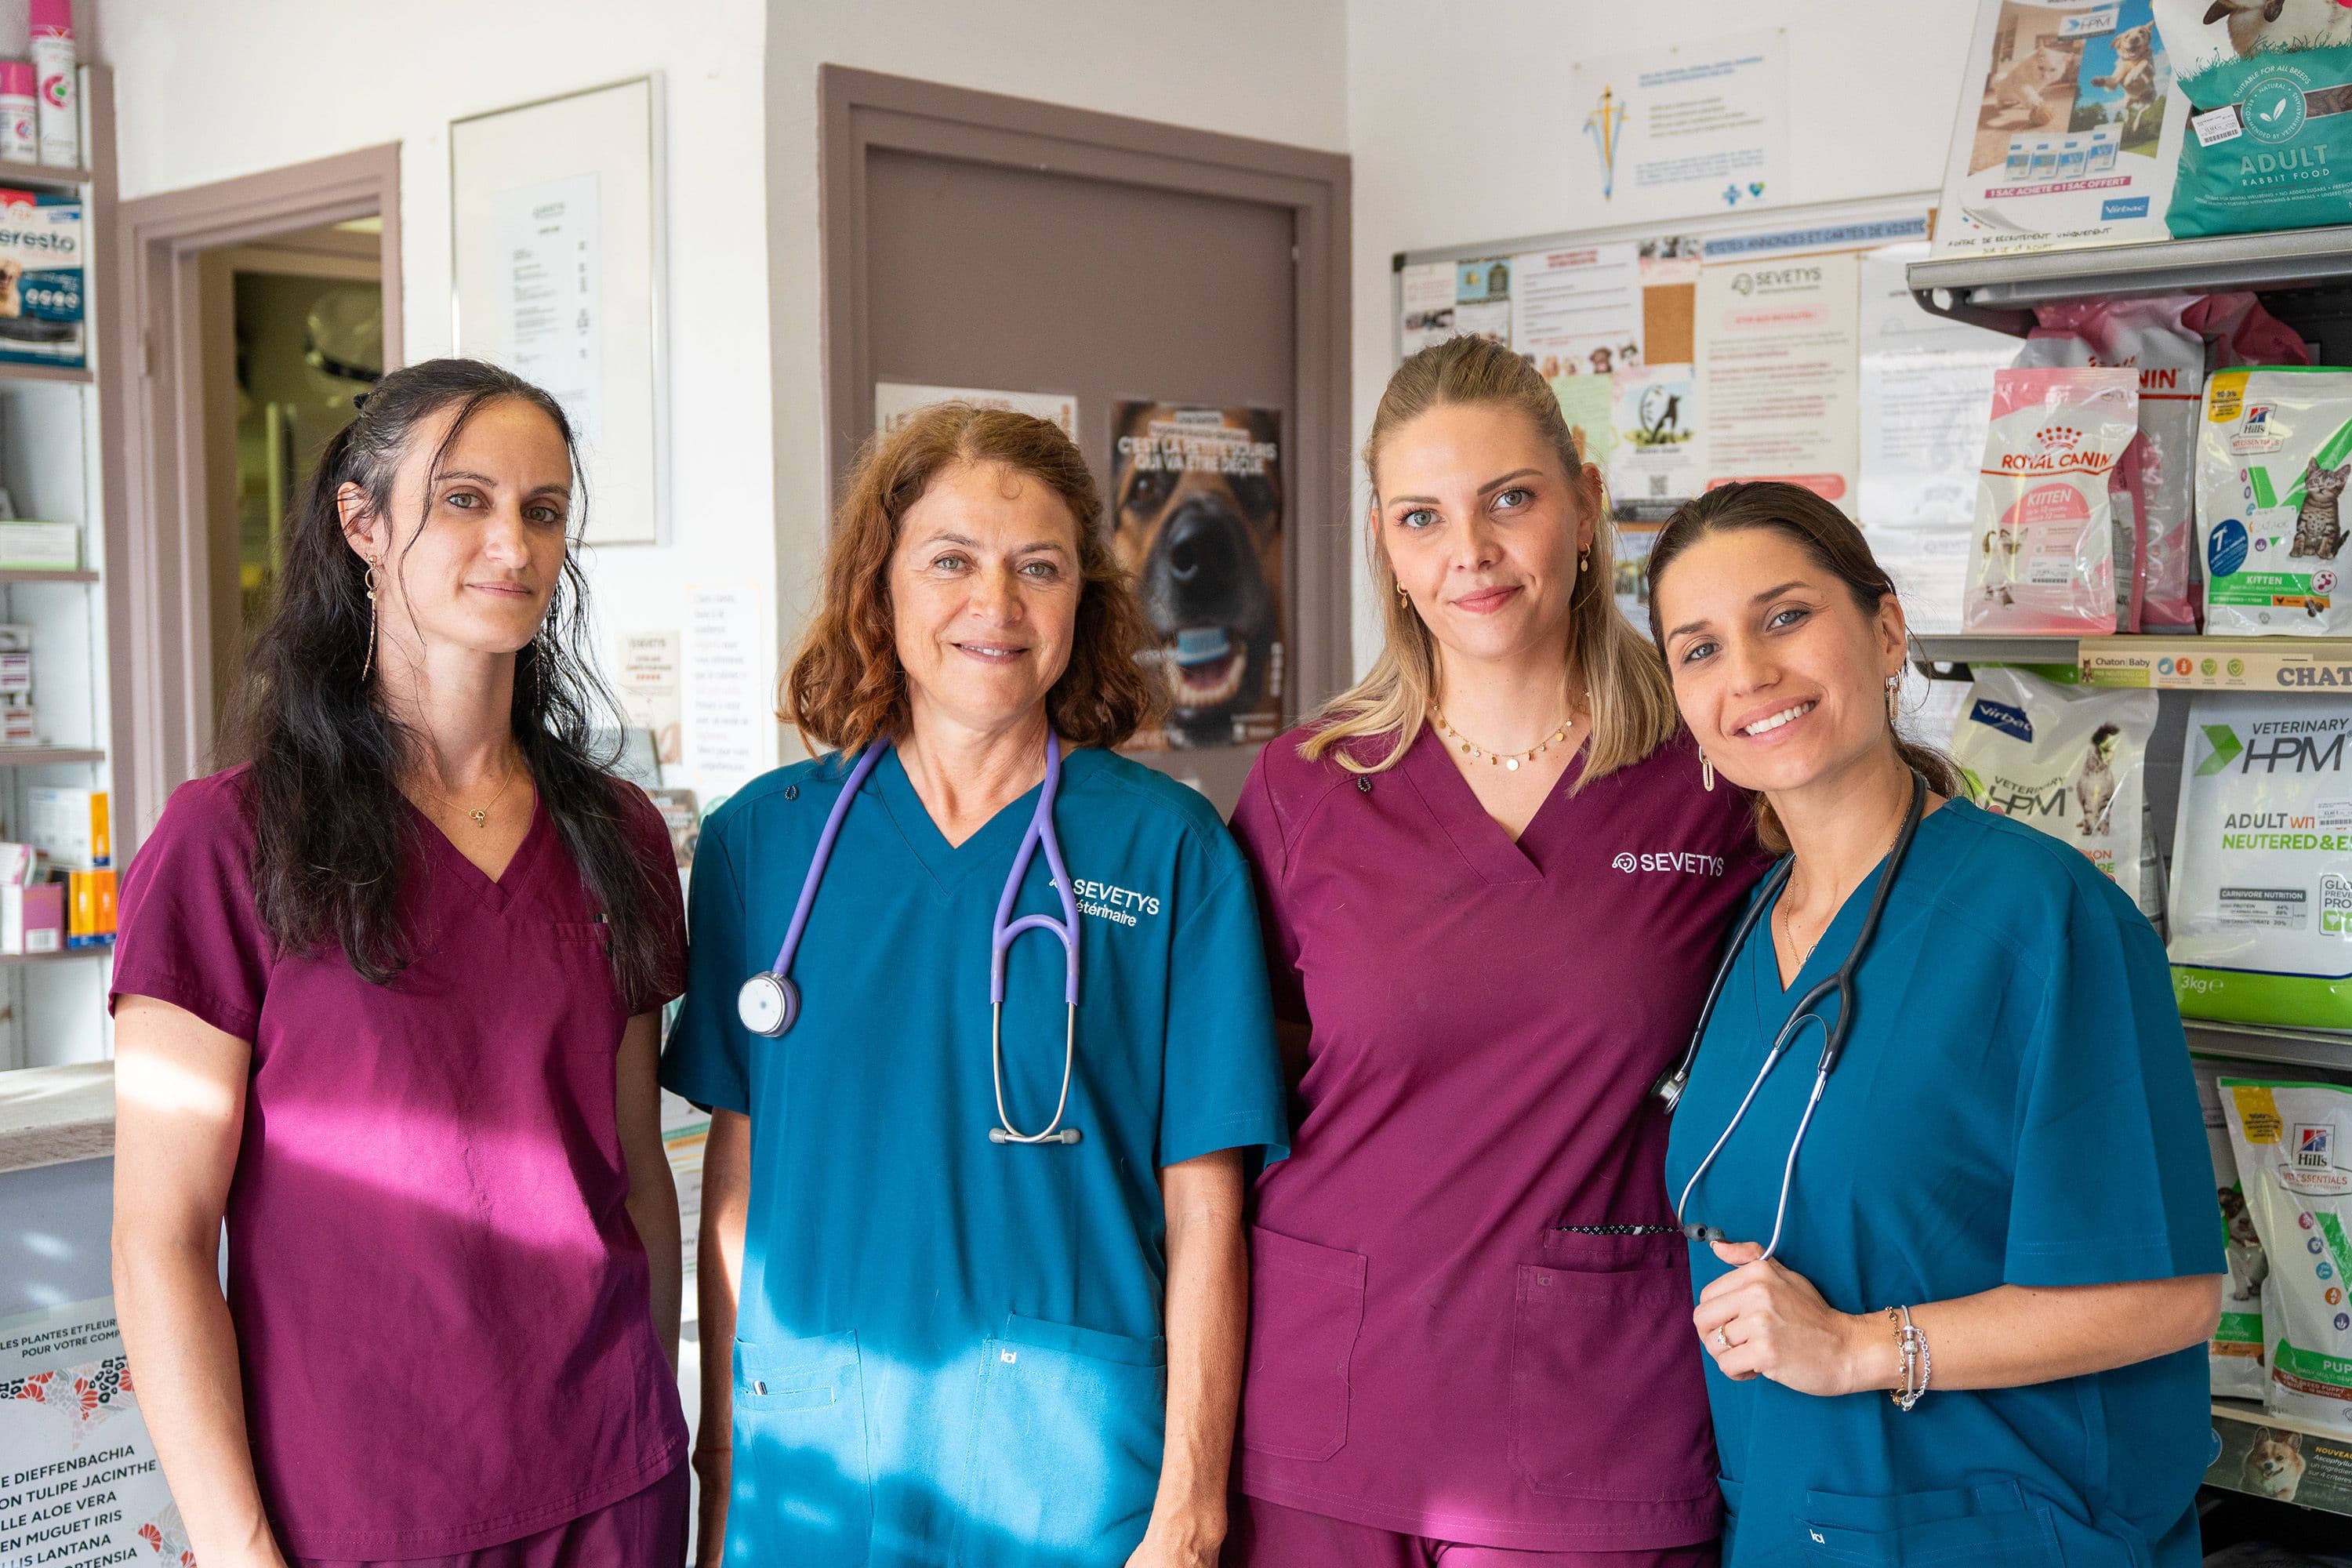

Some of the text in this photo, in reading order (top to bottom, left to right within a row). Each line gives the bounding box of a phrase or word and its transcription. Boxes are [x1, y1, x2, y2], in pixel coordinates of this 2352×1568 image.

[2233, 71, 2259, 98] SUITABLE
[2260, 65, 2275, 74] FOR
[2289, 67, 2311, 85] BREEDS
[2259, 82, 2285, 94] NATURAL
[2245, 99, 2271, 139] RECOMMENDED
[2240, 144, 2328, 176] ADULT
[1996, 188, 2015, 197] SAC
[2067, 182, 2088, 191] SAC
[2089, 178, 2125, 189] OFFERT
[2242, 169, 2330, 187] RABBIT FOOD
[1755, 267, 1822, 285] SEVETYS
[2139, 368, 2176, 389] NIN
[2002, 451, 2114, 470] ROYAL CANIN
[2027, 488, 2072, 507] KITTEN
[2246, 575, 2283, 585] KITTEN
[2095, 657, 2151, 668] Chaton Baby
[2276, 667, 2352, 686] CHAT
[2252, 718, 2350, 735] VETERINARY
[2224, 813, 2288, 829] ADULT
[1640, 851, 1724, 877] SEVETYS
[1073, 879, 1160, 915] SEVETYS
[2221, 889, 2303, 900] CARNIVORE NUTRITION
[1076, 899, 1137, 927] étérinaire
[2180, 975, 2207, 994] 3kg
[2298, 1153, 2328, 1167] Hill's
[21, 1328, 68, 1345] PLANTES
[71, 1325, 83, 1335] ET
[85, 1319, 117, 1332] FLEUR
[22, 1330, 120, 1358] POUR VOTRE COMP
[14, 1445, 135, 1485] DIEFFENBACHIA
[26, 1480, 78, 1502] TULIPE
[82, 1460, 156, 1488] JACINTHE
[31, 1502, 72, 1523] ALOE
[76, 1491, 117, 1510] VERA
[26, 1518, 91, 1546] MUGUET
[95, 1510, 122, 1526] IRIS
[37, 1534, 111, 1564] LANTANA
